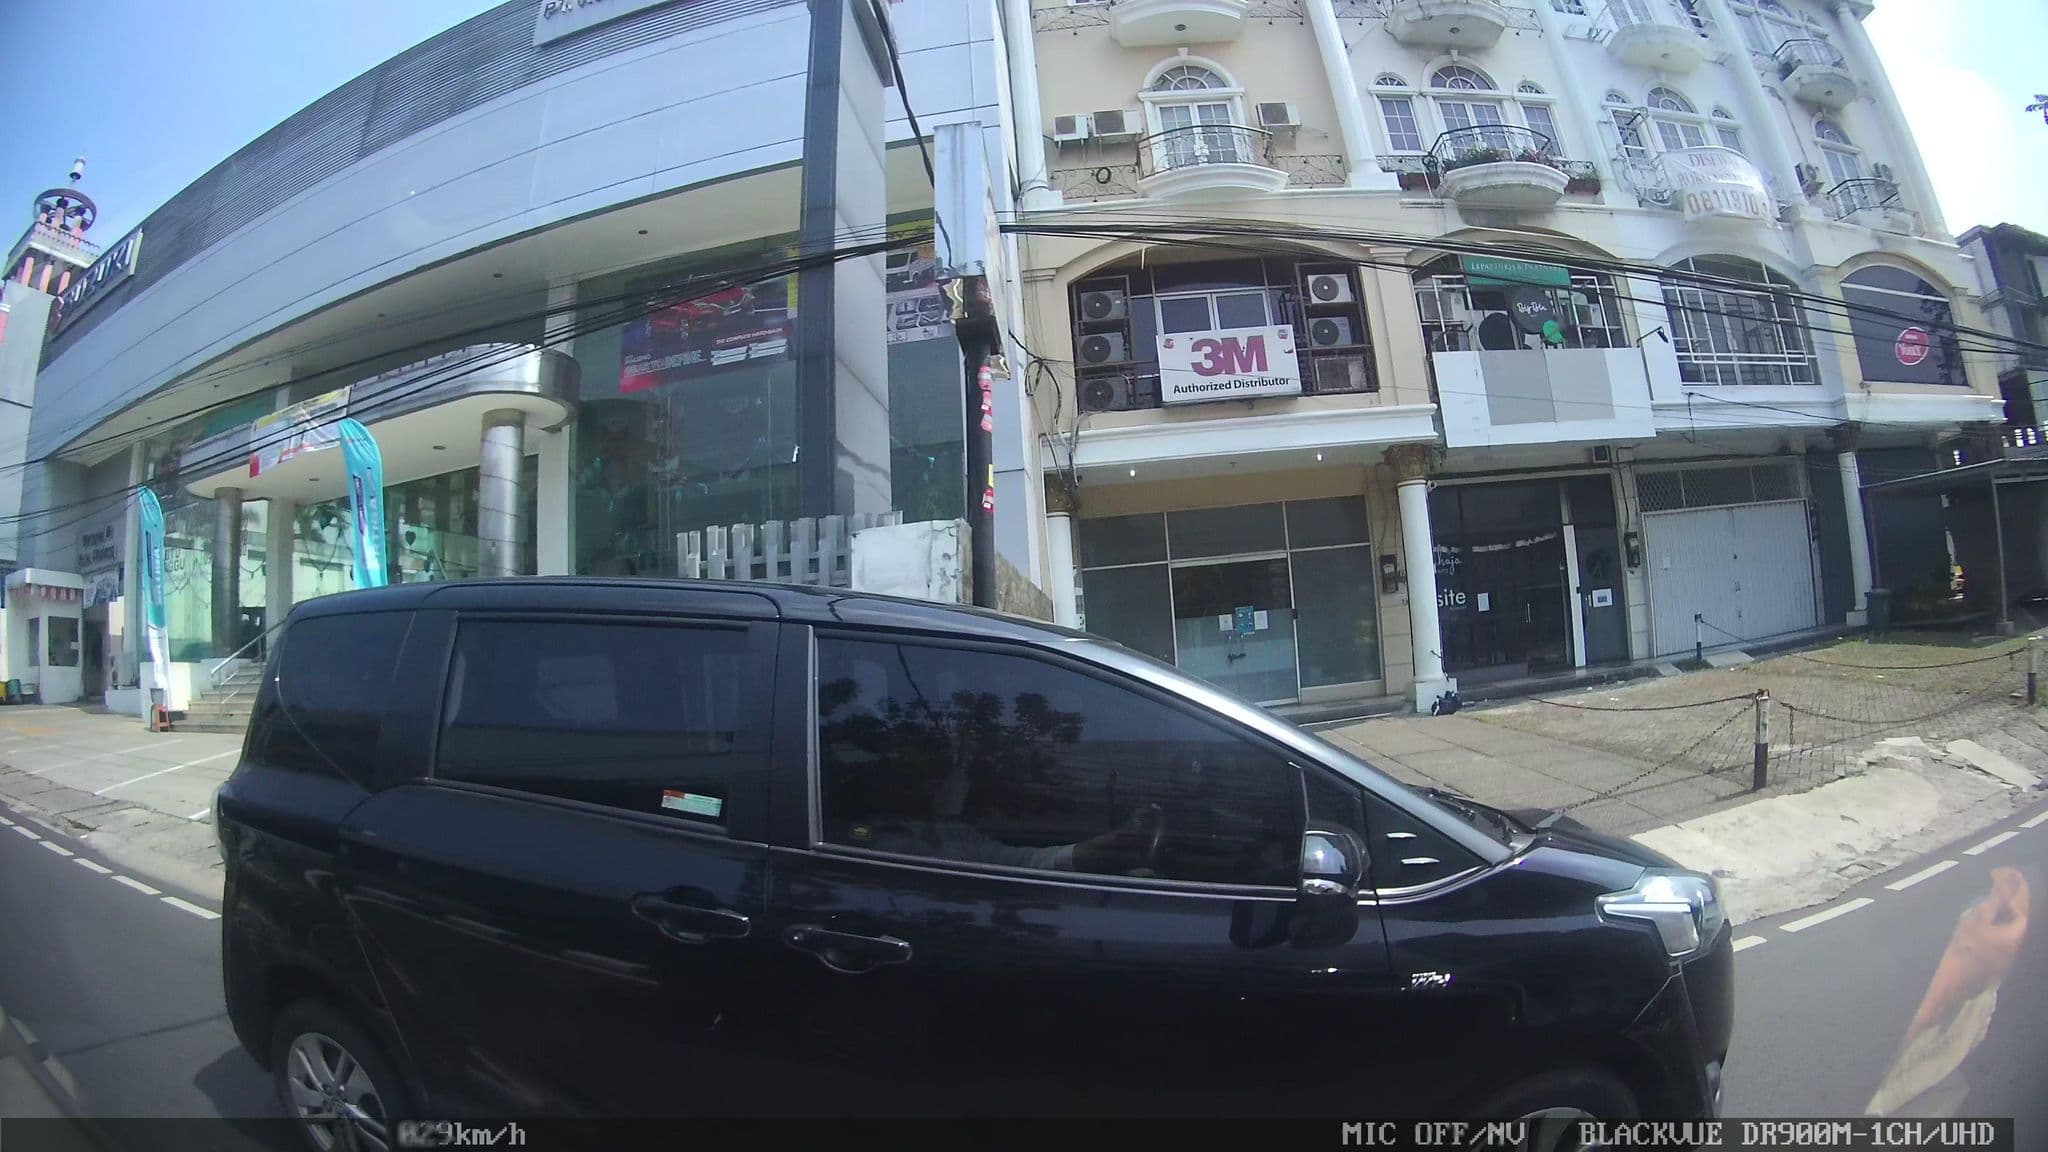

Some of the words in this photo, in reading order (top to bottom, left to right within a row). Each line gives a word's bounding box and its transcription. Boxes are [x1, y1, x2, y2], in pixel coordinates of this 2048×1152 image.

[1191, 335, 1268, 376] 3M
[1173, 381, 1232, 394] Authorized
[1234, 377, 1290, 389] Distributor
